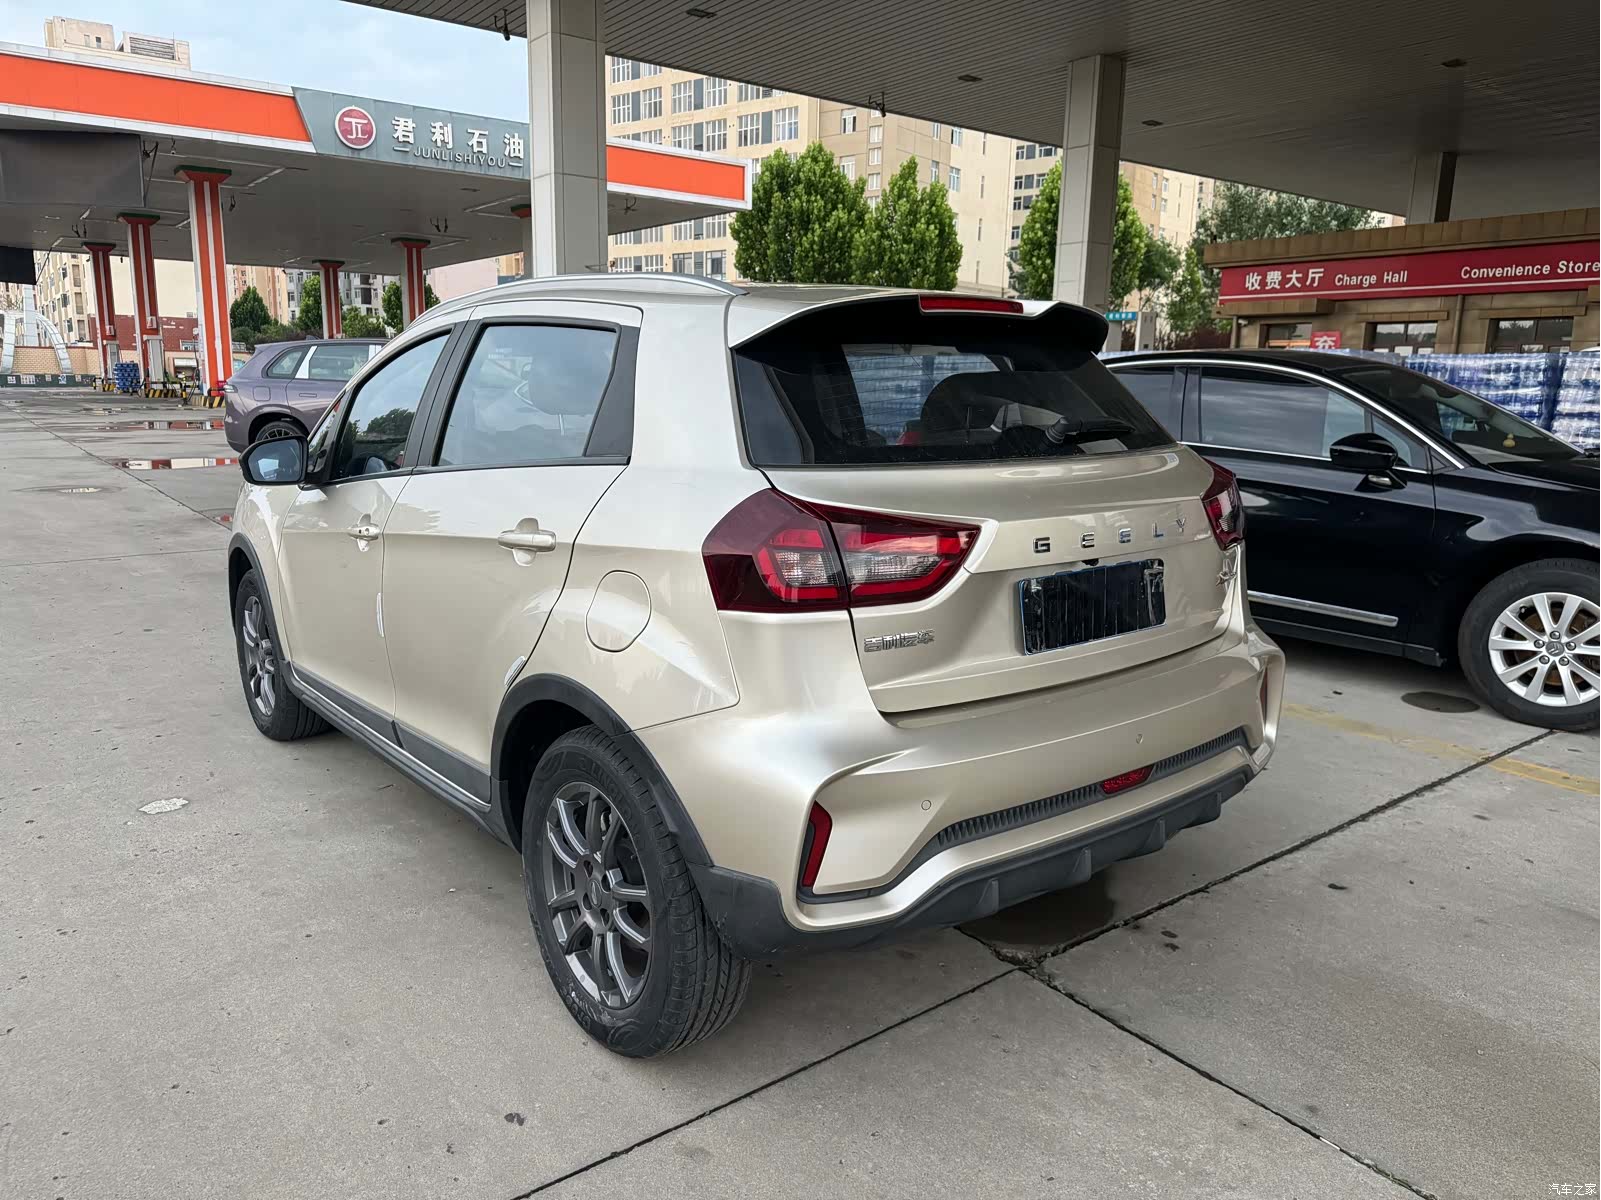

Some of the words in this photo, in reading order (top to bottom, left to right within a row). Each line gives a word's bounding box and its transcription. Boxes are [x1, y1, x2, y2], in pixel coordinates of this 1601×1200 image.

[392, 116, 525, 160] 君利石油
[414, 147, 506, 168] JUNLISHIYOU
[1245, 268, 1325, 291] 收费大厅
[1335, 273, 1377, 288] Charge
[1383, 270, 1408, 284] Hall
[1460, 262, 1551, 280] Convenience
[1556, 259, 1600, 274] Store
[1033, 517, 1187, 554] GEELY
[863, 628, 935, 653] 吉利汽车
